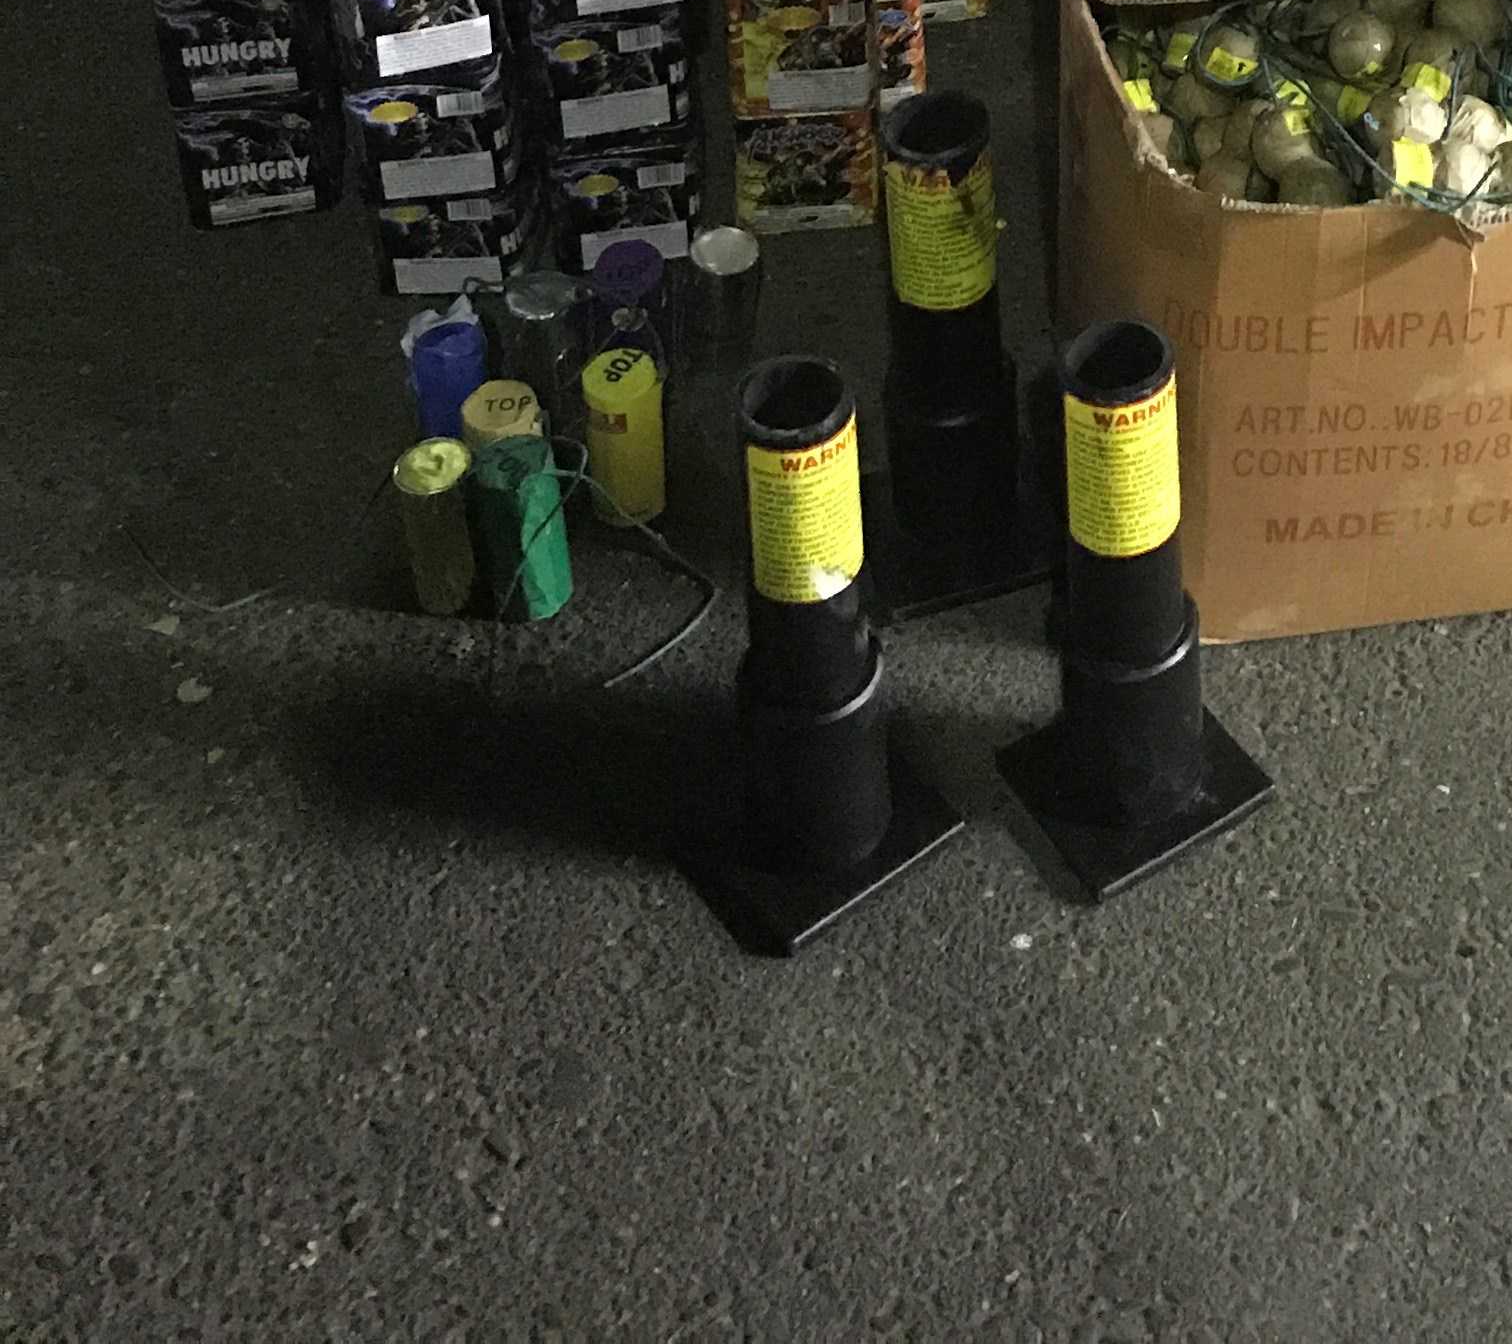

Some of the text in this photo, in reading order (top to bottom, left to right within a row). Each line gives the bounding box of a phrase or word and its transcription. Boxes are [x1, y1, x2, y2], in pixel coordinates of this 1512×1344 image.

[181, 37, 292, 68] HUNGRY
[202, 157, 310, 191] HUNGRY
[1165, 299, 1330, 355] DOUBLE
[605, 349, 644, 383] TOP
[484, 395, 533, 414] TOP
[1093, 389, 1175, 427] WARNIN
[1441, 432, 1512, 466] 18/8
[1265, 511, 1397, 545] MADE
